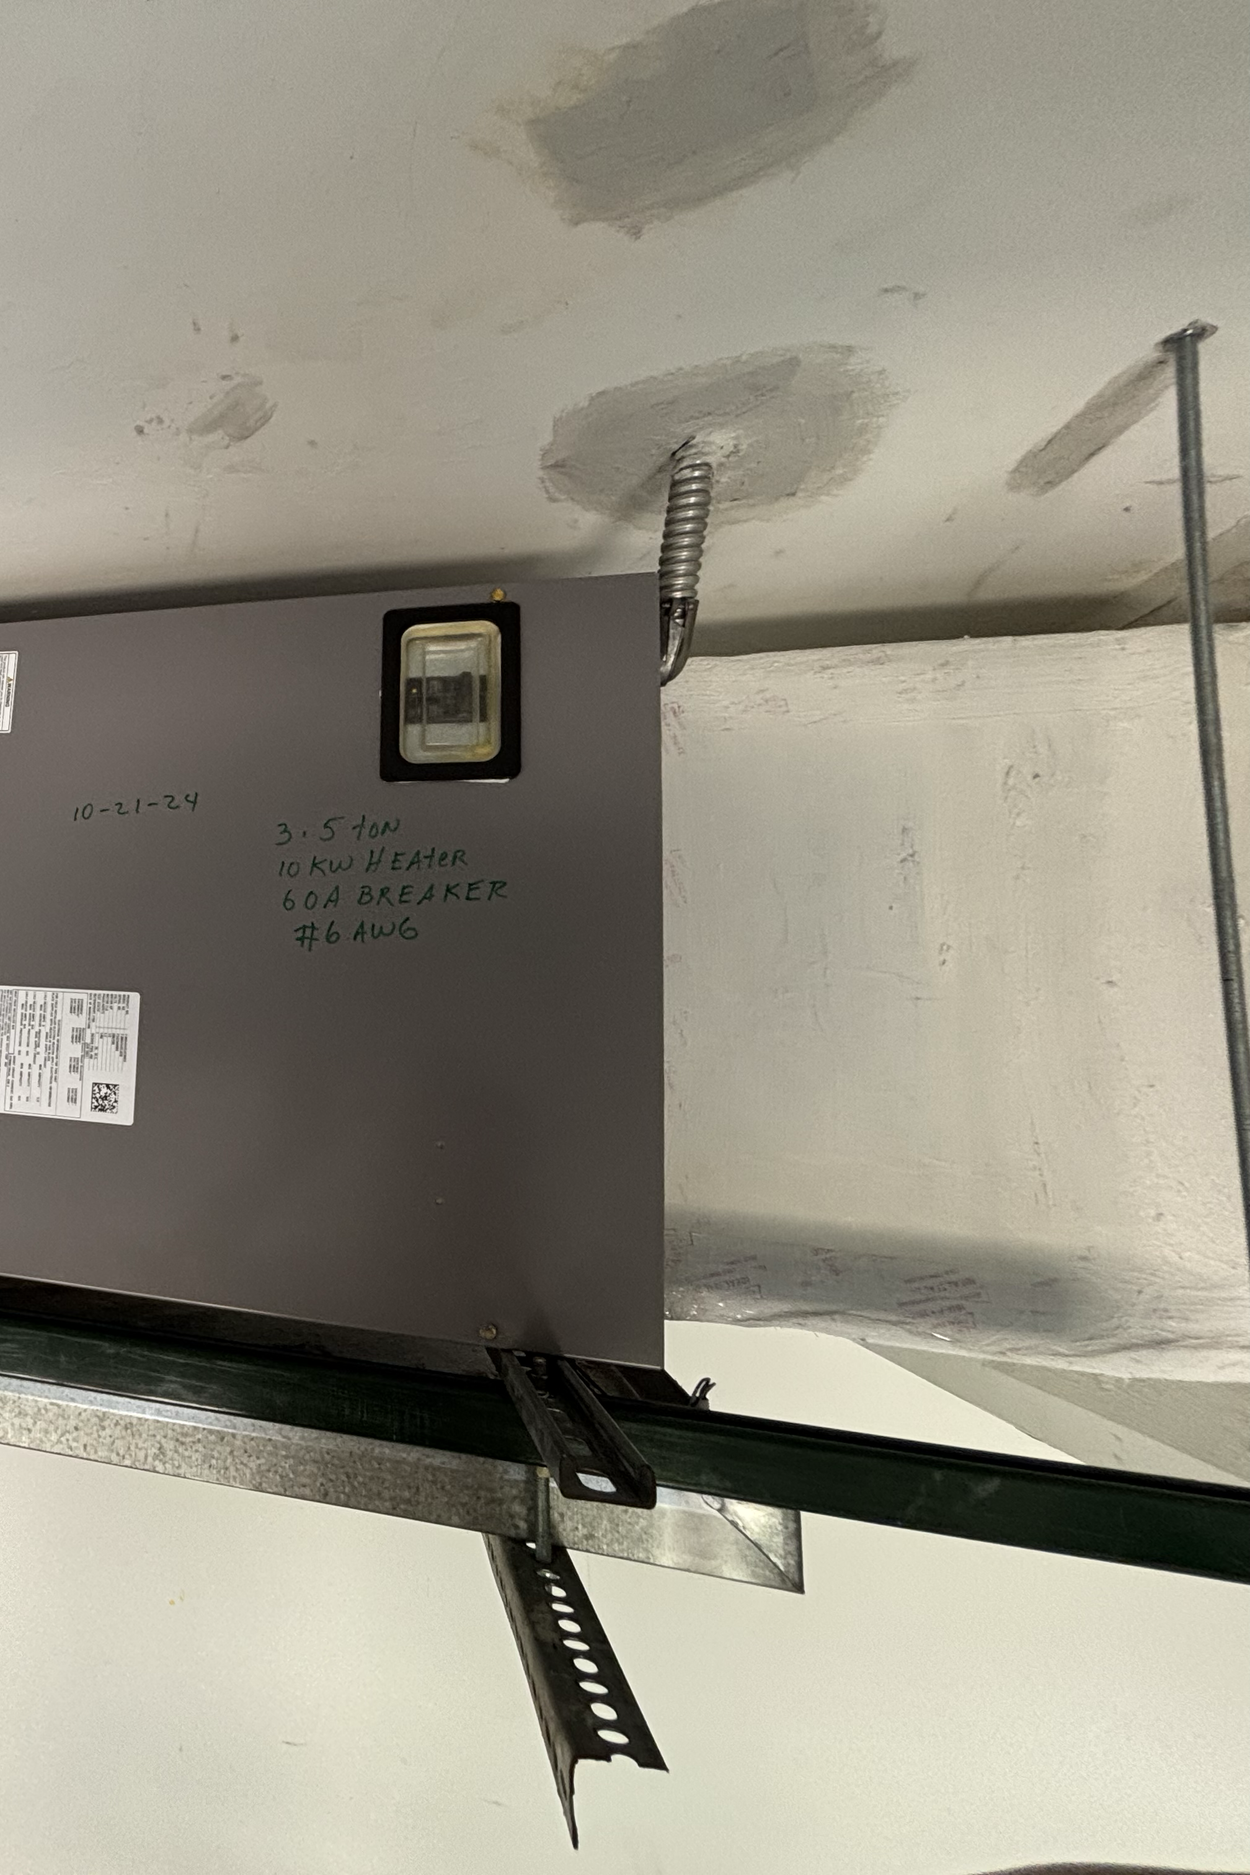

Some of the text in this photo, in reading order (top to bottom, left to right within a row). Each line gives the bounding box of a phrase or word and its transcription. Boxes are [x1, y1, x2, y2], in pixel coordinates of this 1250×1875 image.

[73, 791, 199, 822] 10-21-24
[357, 879, 509, 907] BREAKER
[293, 916, 419, 952] #6 AWG
